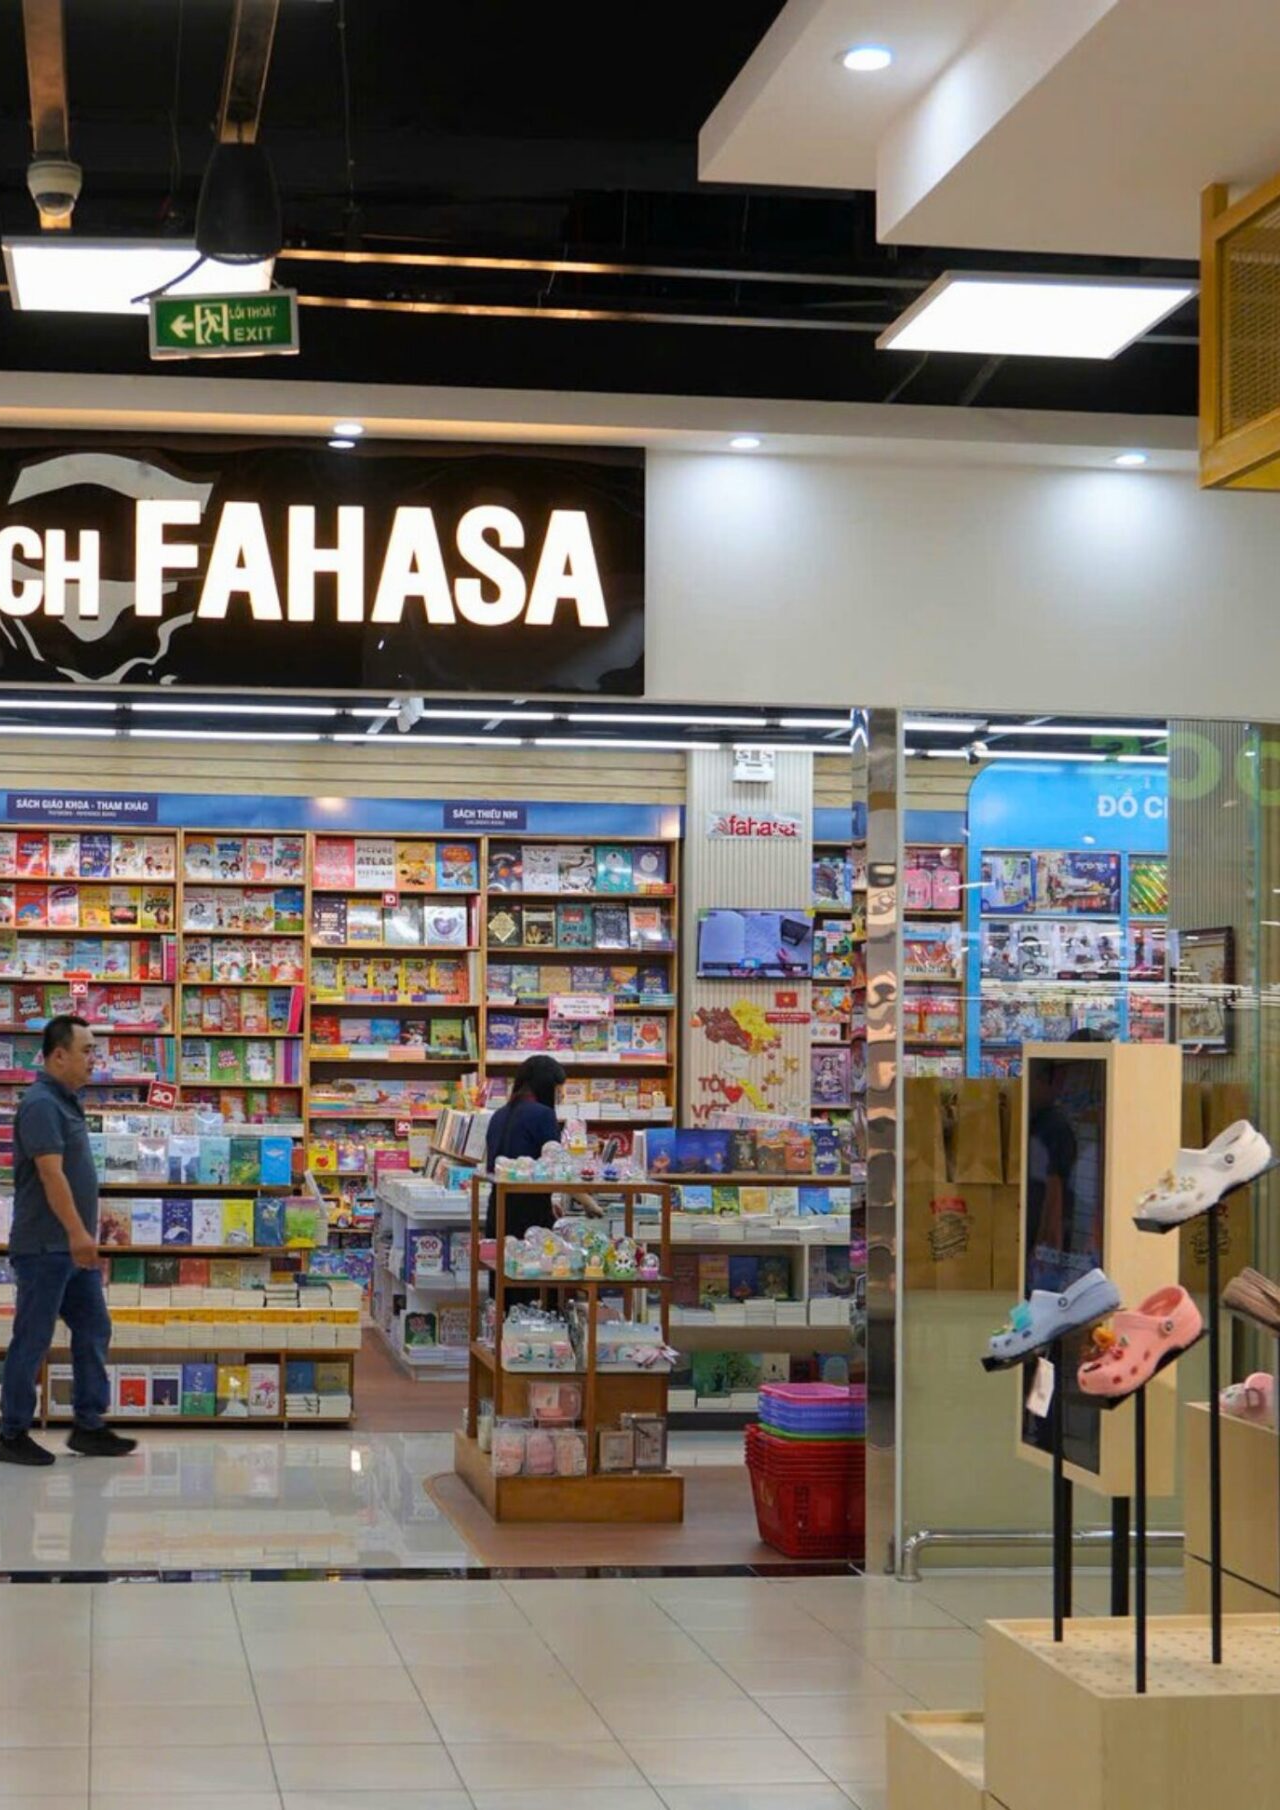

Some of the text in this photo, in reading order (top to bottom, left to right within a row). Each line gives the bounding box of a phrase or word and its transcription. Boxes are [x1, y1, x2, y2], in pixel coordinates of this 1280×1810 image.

[233, 327, 274, 342] EXIT
[134, 499, 609, 627] FAHASA
[16, 798, 40, 809] SÁCH
[65, 800, 89, 810] KHOA
[97, 800, 123, 811] THAM
[1143, 796, 1168, 819] C
[452, 807, 476, 819] SÁCH
[503, 810, 518, 819] NHI
[152, 1088, 173, 1103] 20
